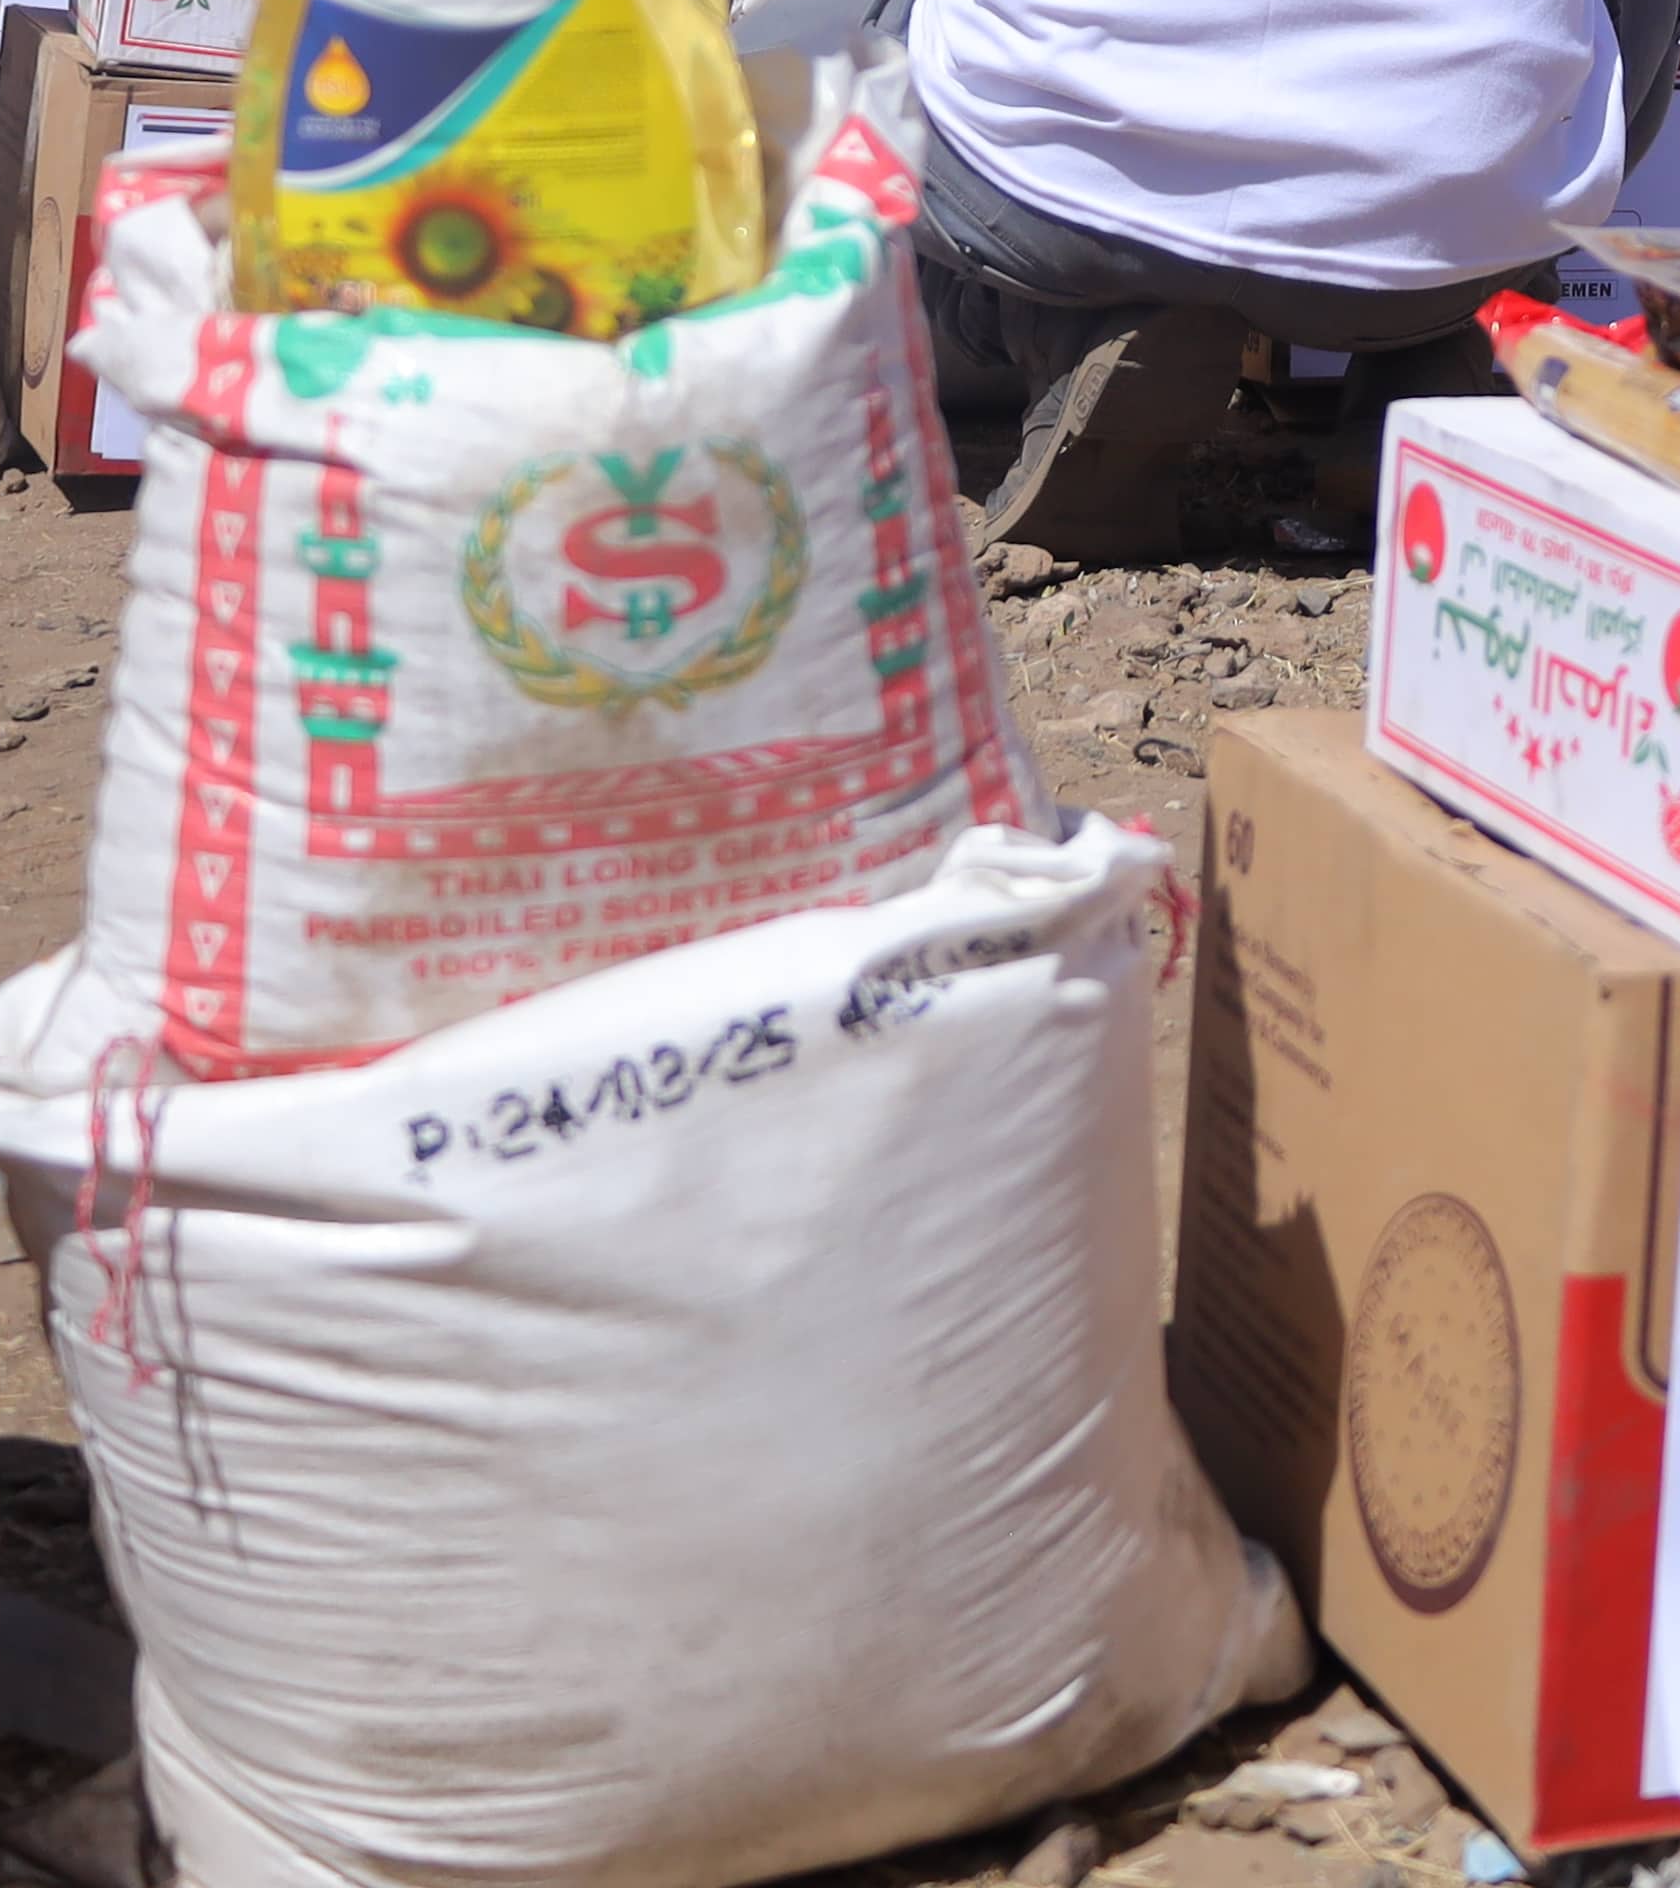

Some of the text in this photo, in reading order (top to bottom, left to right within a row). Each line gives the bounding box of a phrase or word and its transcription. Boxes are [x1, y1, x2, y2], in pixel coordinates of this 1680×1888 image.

[1561, 282, 1612, 298] EMEN
[427, 814, 856, 900] THAI LONG GRAIN
[304, 900, 576, 946] PARBOILED
[597, 862, 843, 927] SORTEXED
[407, 948, 541, 983] 100%
